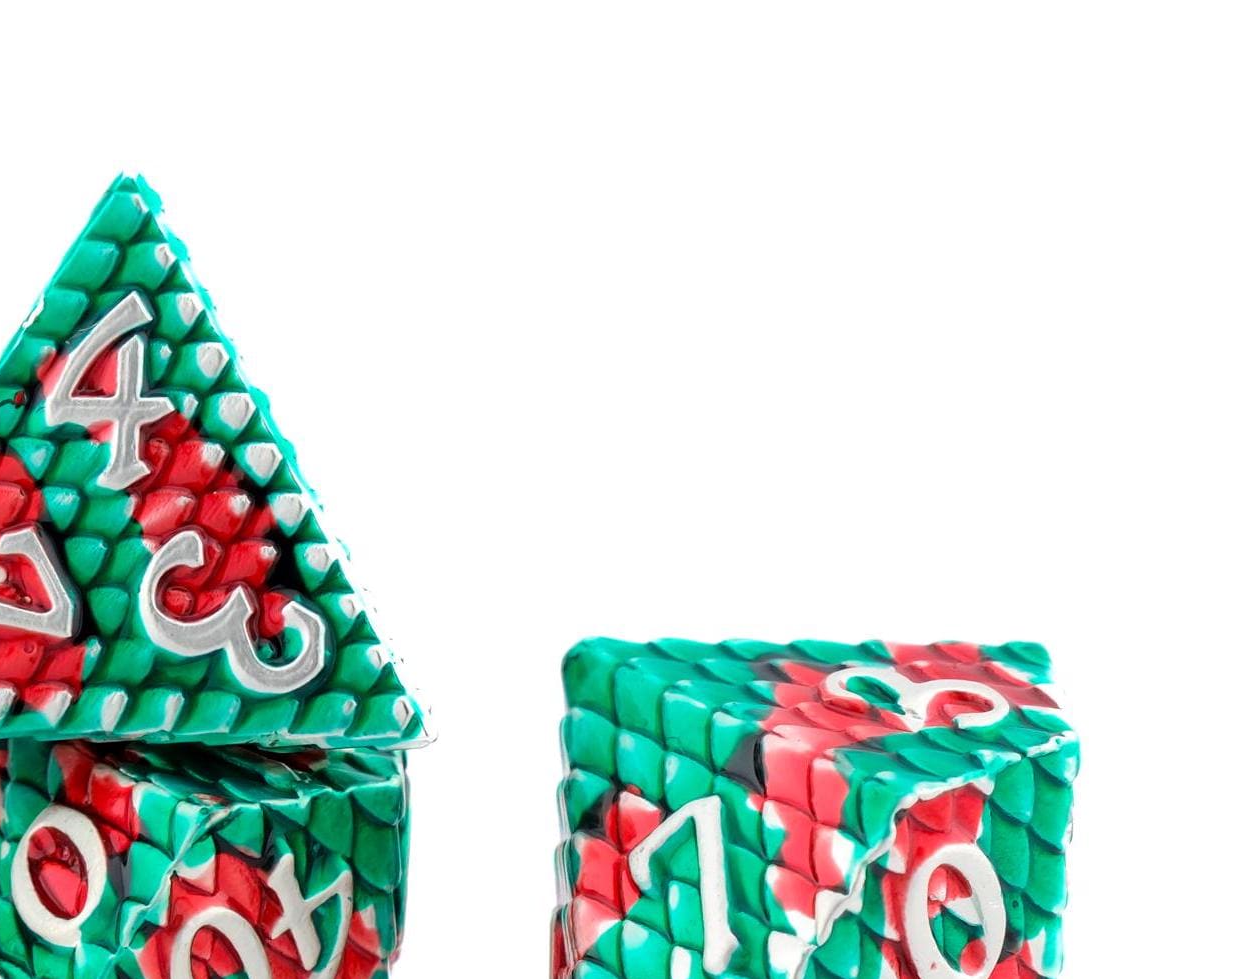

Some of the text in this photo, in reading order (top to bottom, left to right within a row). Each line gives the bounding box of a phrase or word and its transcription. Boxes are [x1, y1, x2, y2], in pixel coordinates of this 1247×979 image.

[46, 291, 175, 490] 4
[141, 530, 325, 694] 3
[822, 666, 1010, 732] 3
[628, 795, 740, 976] 7
